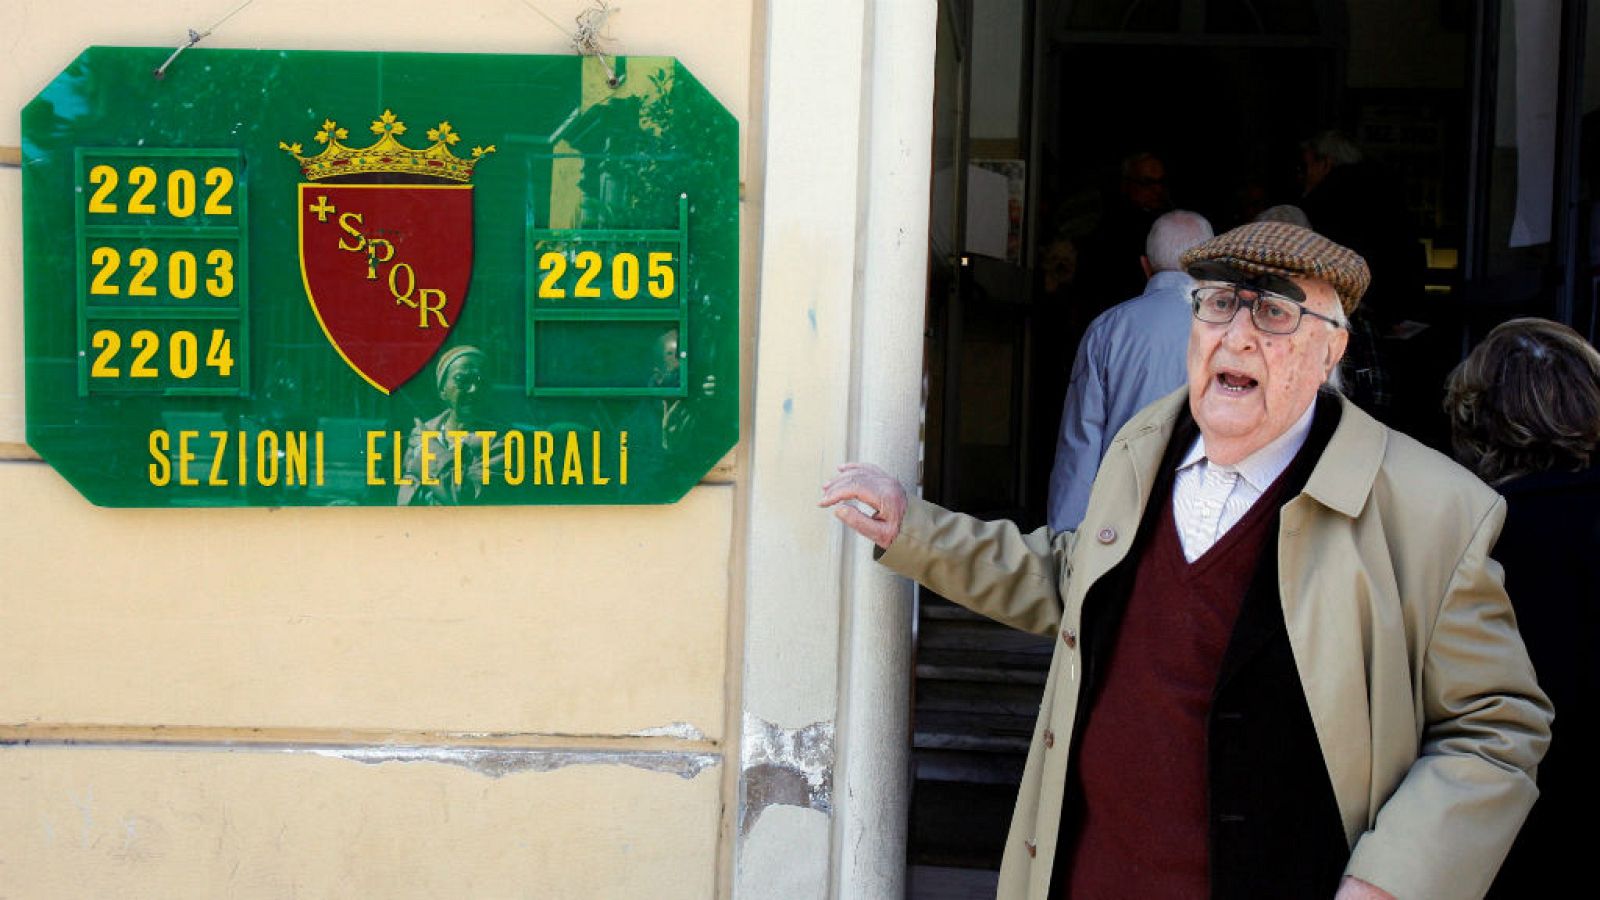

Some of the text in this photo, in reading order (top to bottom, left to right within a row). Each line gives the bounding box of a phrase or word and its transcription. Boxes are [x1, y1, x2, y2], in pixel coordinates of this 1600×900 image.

[88, 165, 234, 219] 2202
[90, 247, 235, 300] 2203
[337, 211, 450, 329] SPQR
[537, 251, 675, 301] 2205
[91, 329, 235, 379] 2204
[148, 430, 629, 487] SEZIONI ELETTORALI
